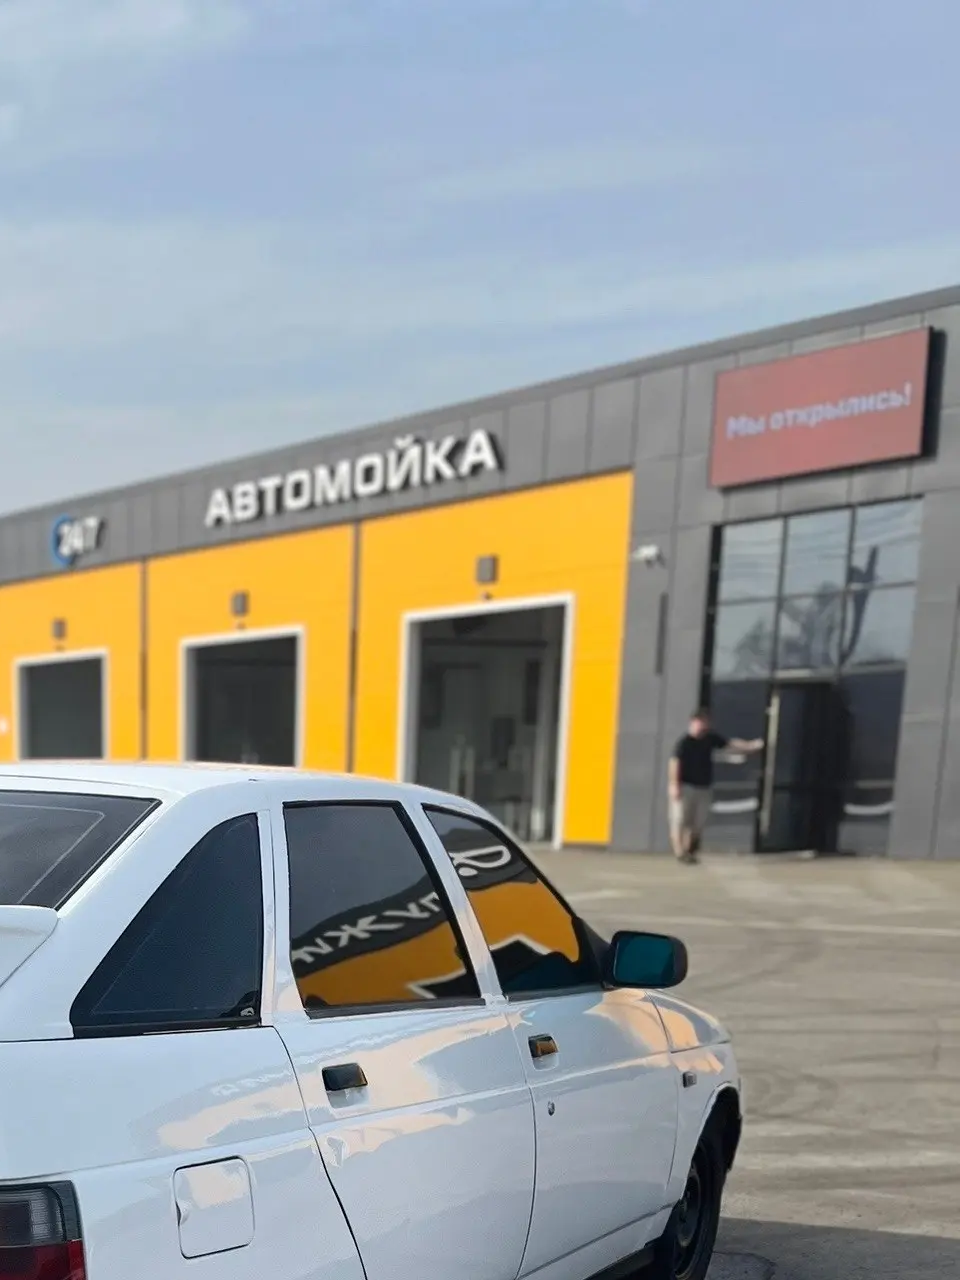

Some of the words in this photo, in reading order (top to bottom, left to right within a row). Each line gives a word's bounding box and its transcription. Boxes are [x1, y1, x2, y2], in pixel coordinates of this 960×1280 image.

[726, 416, 766, 439] Мы
[770, 381, 912, 429] открылись!
[205, 428, 497, 527] АВТОМОЙКА
